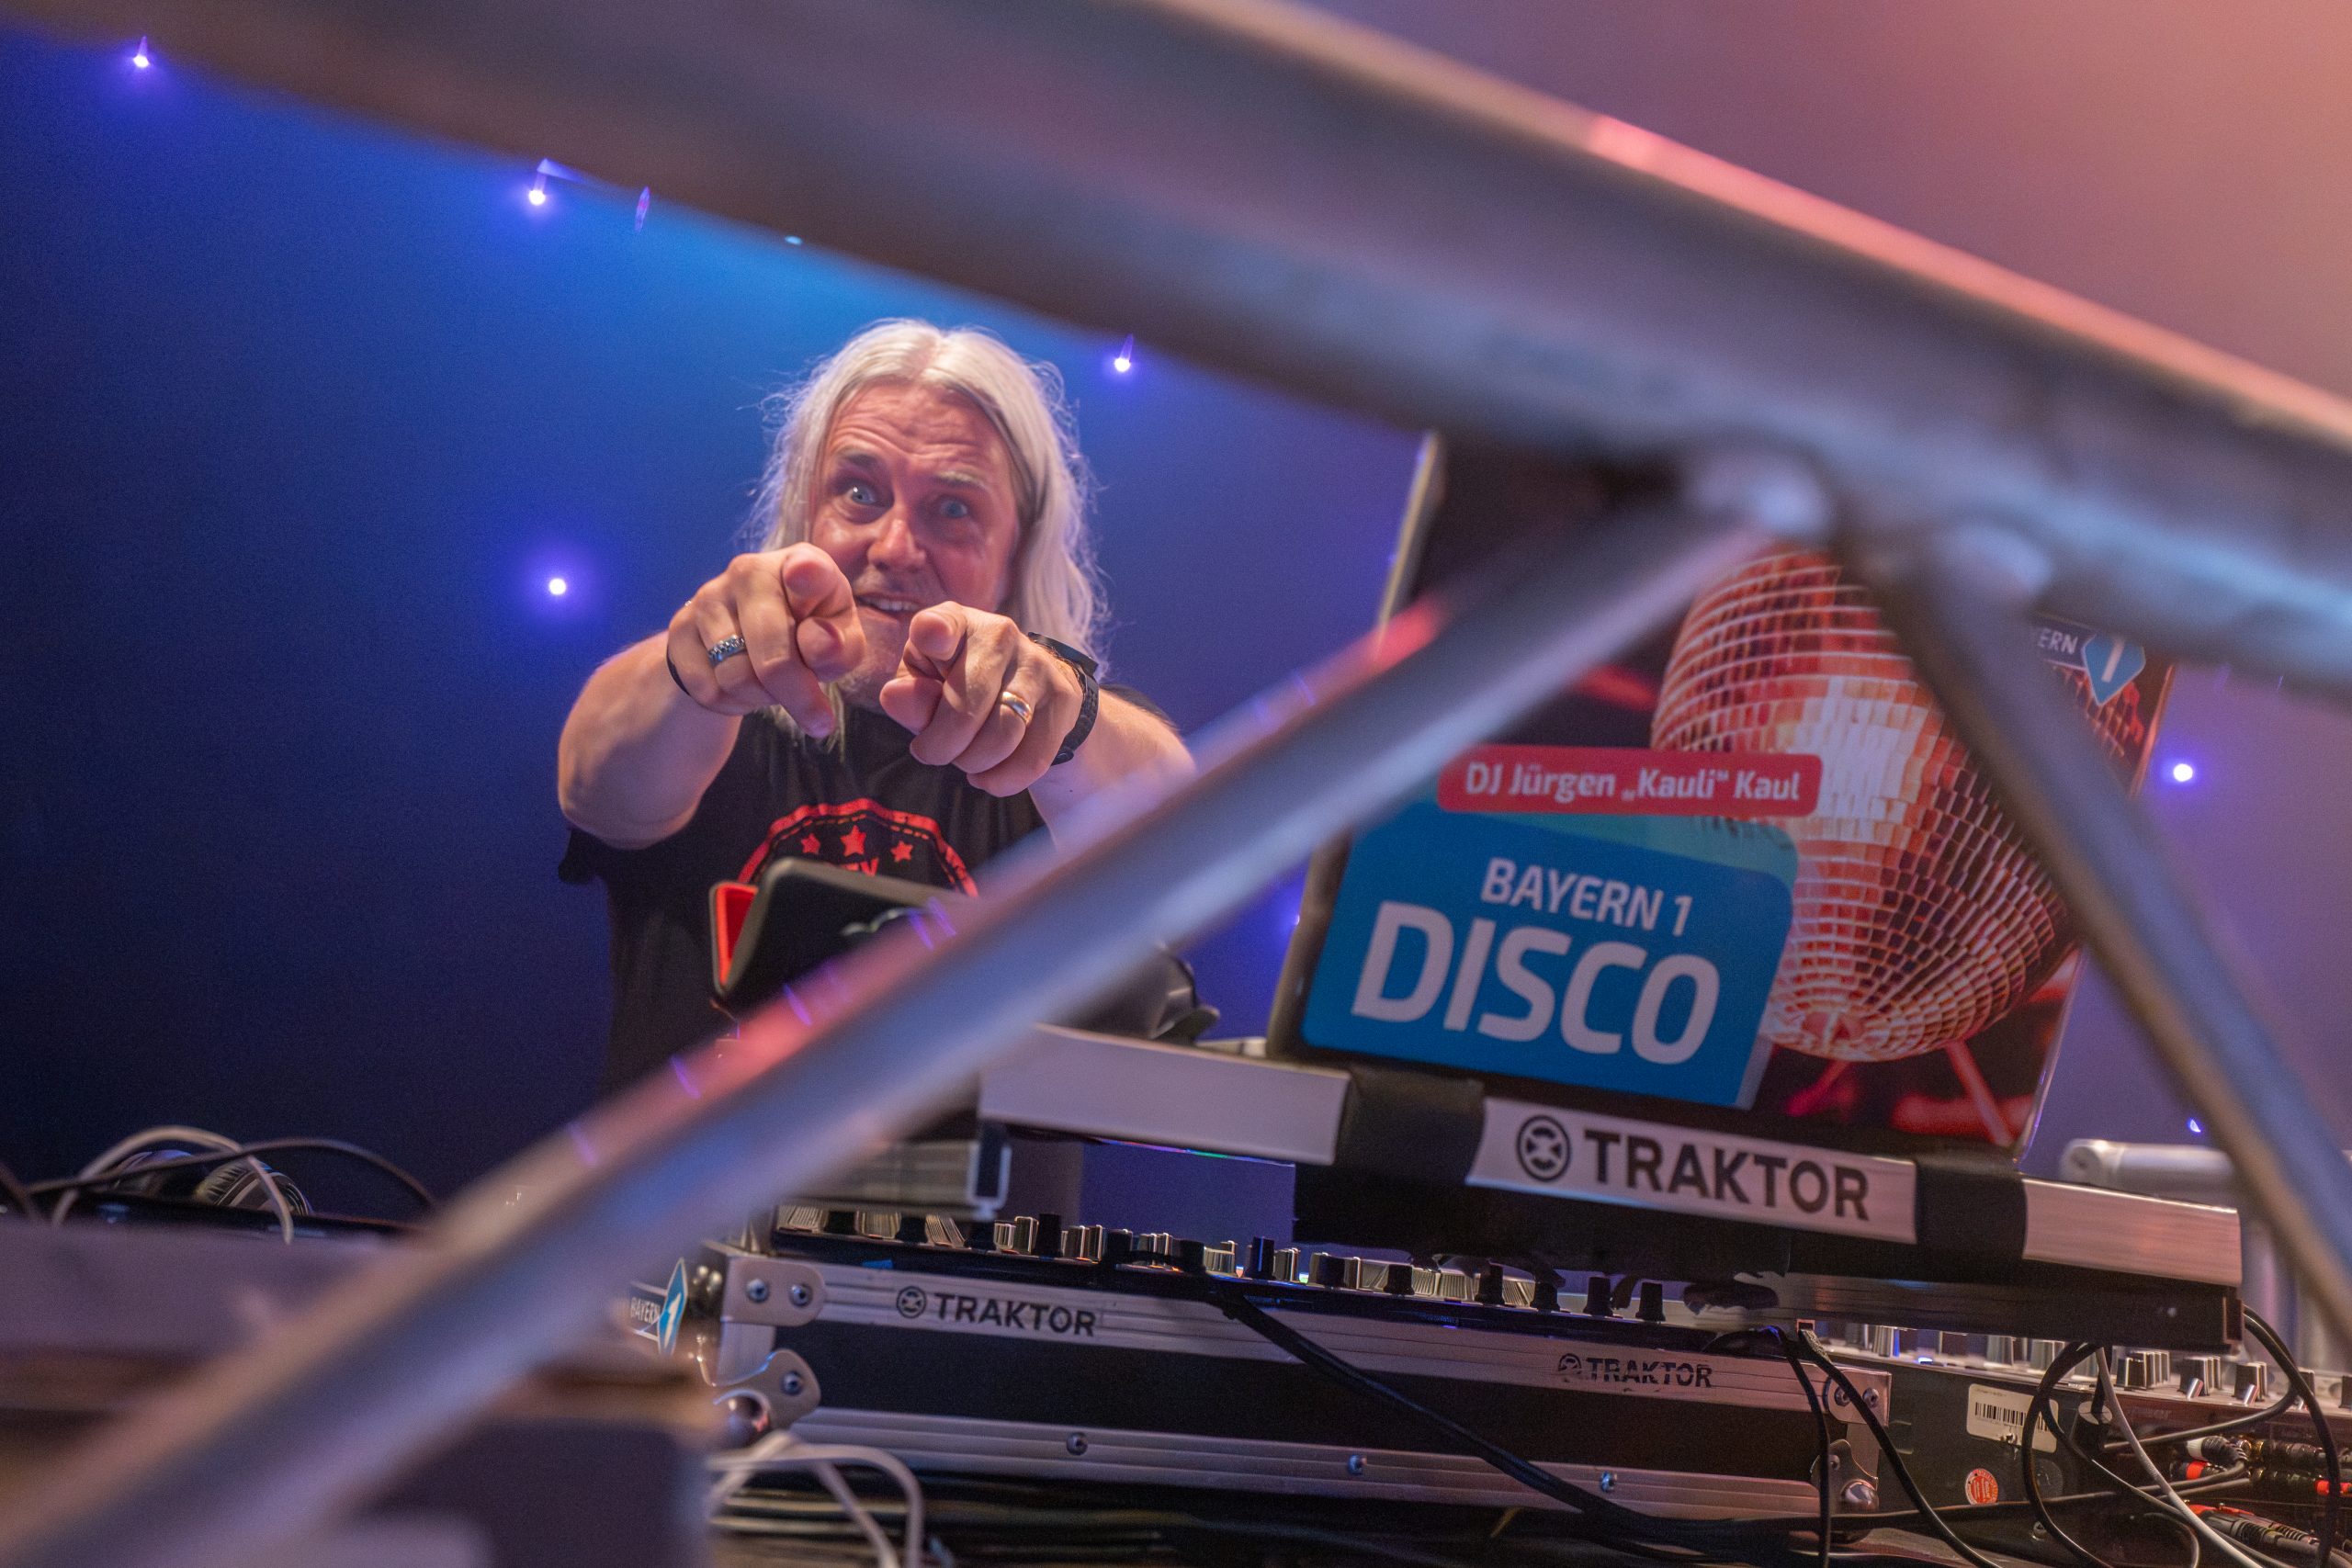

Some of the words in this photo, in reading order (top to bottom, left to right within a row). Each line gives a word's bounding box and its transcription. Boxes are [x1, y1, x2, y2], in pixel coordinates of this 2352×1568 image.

[1464, 761, 1502, 795] DJ
[1508, 763, 1615, 804] Jürgen
[1733, 771, 1801, 801] Kaul
[1480, 858, 1664, 935] BAYERN
[1671, 895, 1693, 937] 1
[1351, 901, 1721, 1065] DISCO
[1583, 1129, 1870, 1222] TRAKTOR
[663, 1292, 683, 1349] 1
[934, 1292, 1096, 1337] TRAKTOR
[1586, 1357, 1713, 1388] TRAKTOR
